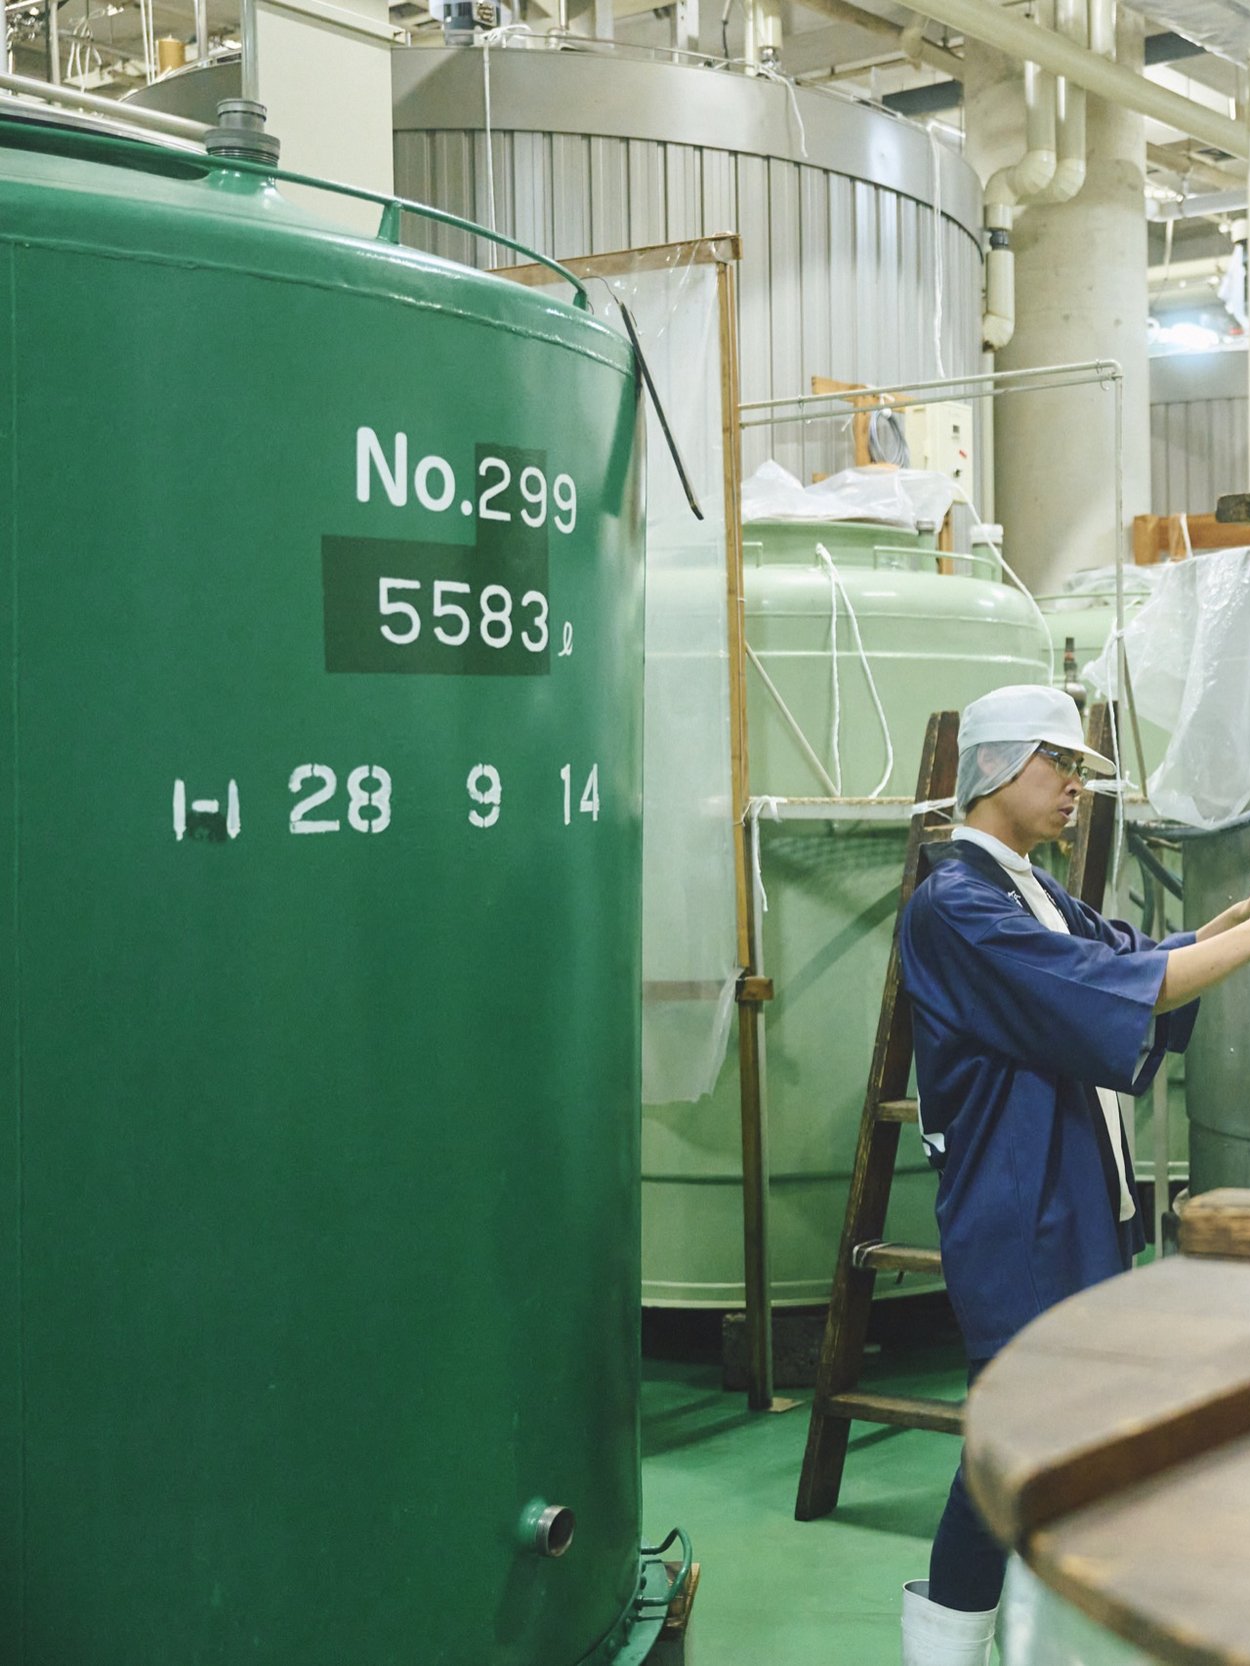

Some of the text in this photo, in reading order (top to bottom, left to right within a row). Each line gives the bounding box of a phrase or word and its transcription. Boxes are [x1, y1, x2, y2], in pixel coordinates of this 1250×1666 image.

[172, 762, 600, 841] H 28 9 14
